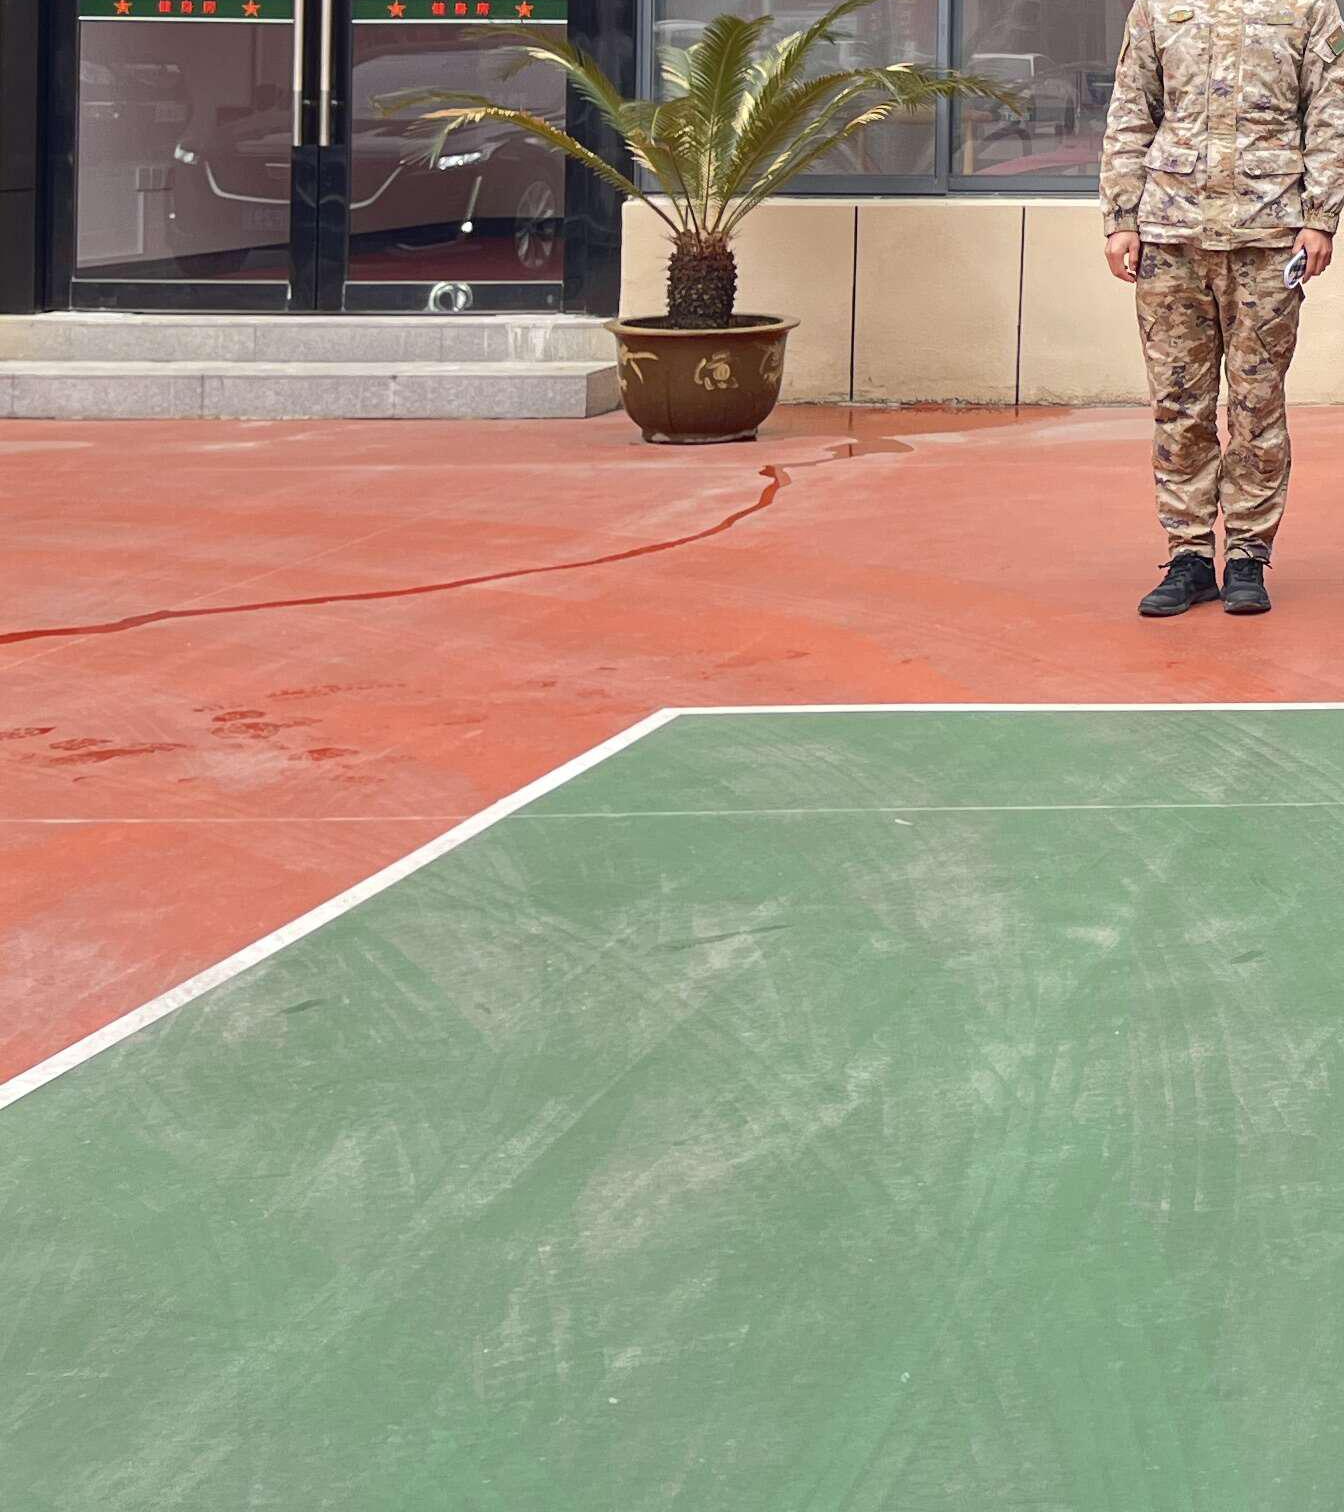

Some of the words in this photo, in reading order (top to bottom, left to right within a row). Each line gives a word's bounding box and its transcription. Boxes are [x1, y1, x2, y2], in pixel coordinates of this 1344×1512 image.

[157, 0, 218, 15] 健身房
[431, 0, 492, 16] 健身房
